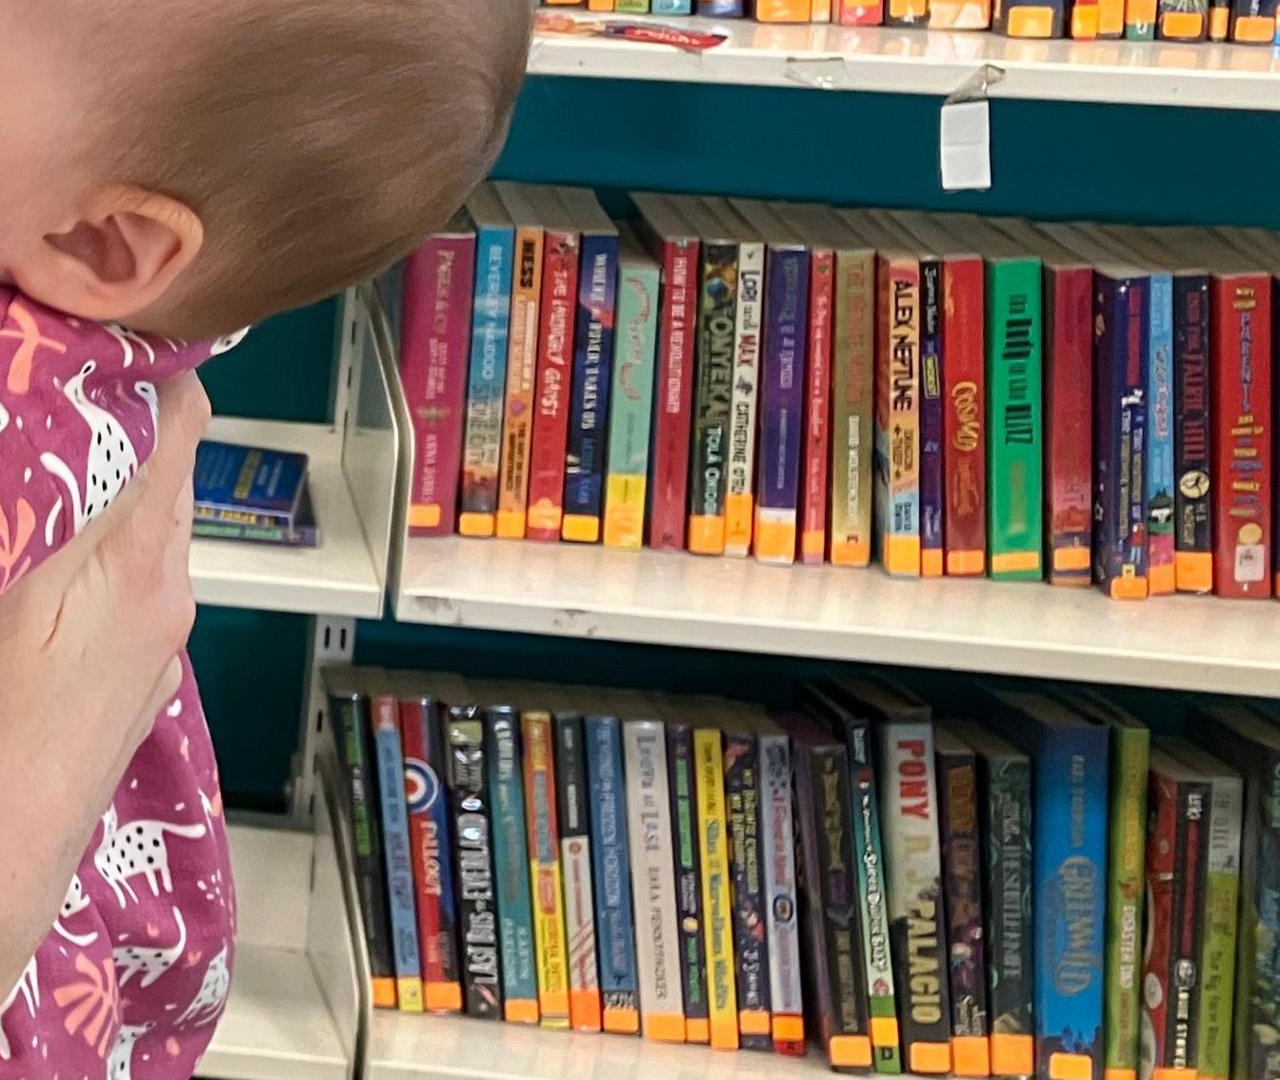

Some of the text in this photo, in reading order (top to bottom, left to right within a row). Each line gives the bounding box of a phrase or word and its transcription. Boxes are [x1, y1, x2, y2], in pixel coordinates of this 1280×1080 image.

[519, 239, 535, 289] NESS
[671, 256, 686, 328] HOW TO BE A
[736, 270, 760, 368] LORI and MAX
[892, 280, 914, 412] ALEX NEPTUNE
[897, 739, 929, 819] PONY
